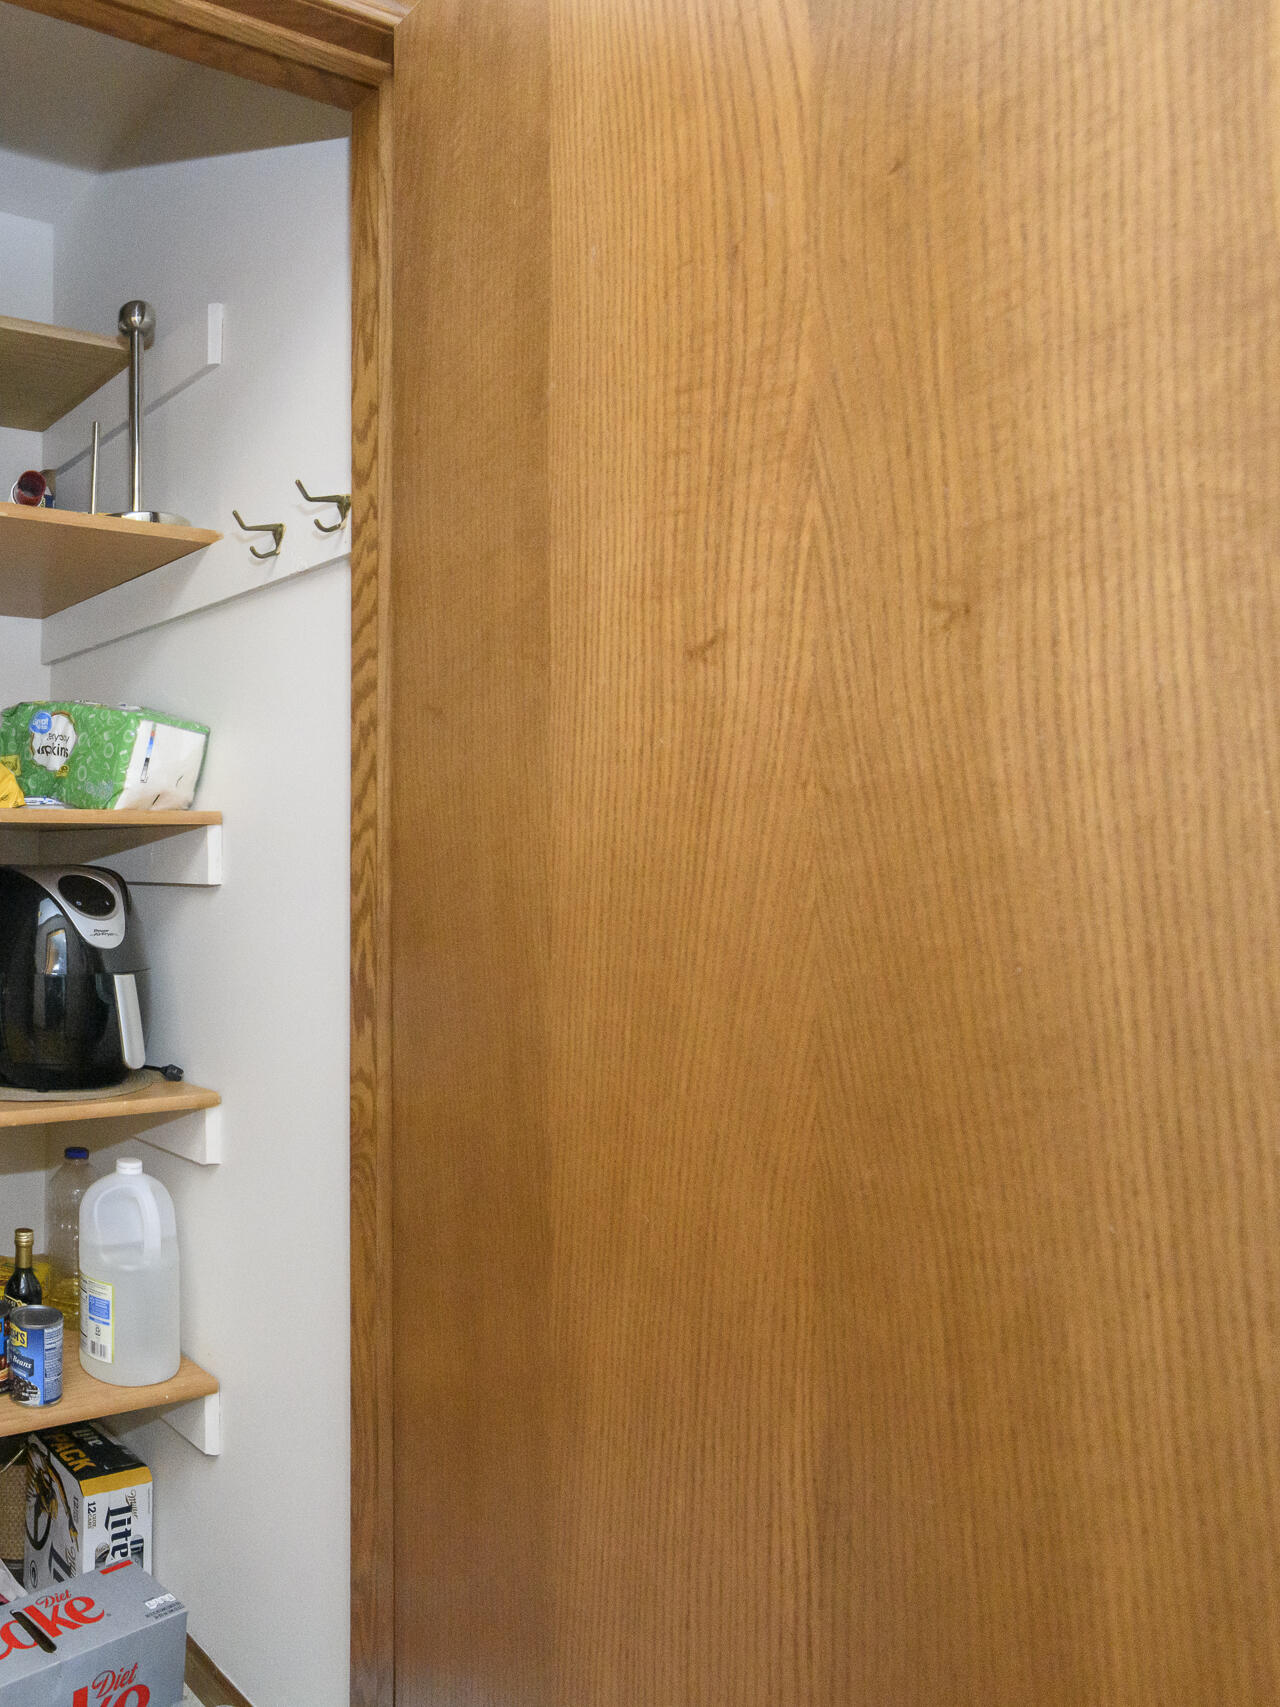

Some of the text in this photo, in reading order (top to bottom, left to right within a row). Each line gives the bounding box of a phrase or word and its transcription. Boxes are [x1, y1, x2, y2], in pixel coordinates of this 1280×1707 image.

[12, 1355, 33, 1369] Beans
[87, 1501, 97, 1513] 12
[104, 1503, 133, 1561] Lite
[35, 1589, 72, 1609] Diet
[92, 1662, 139, 1699] Diet
